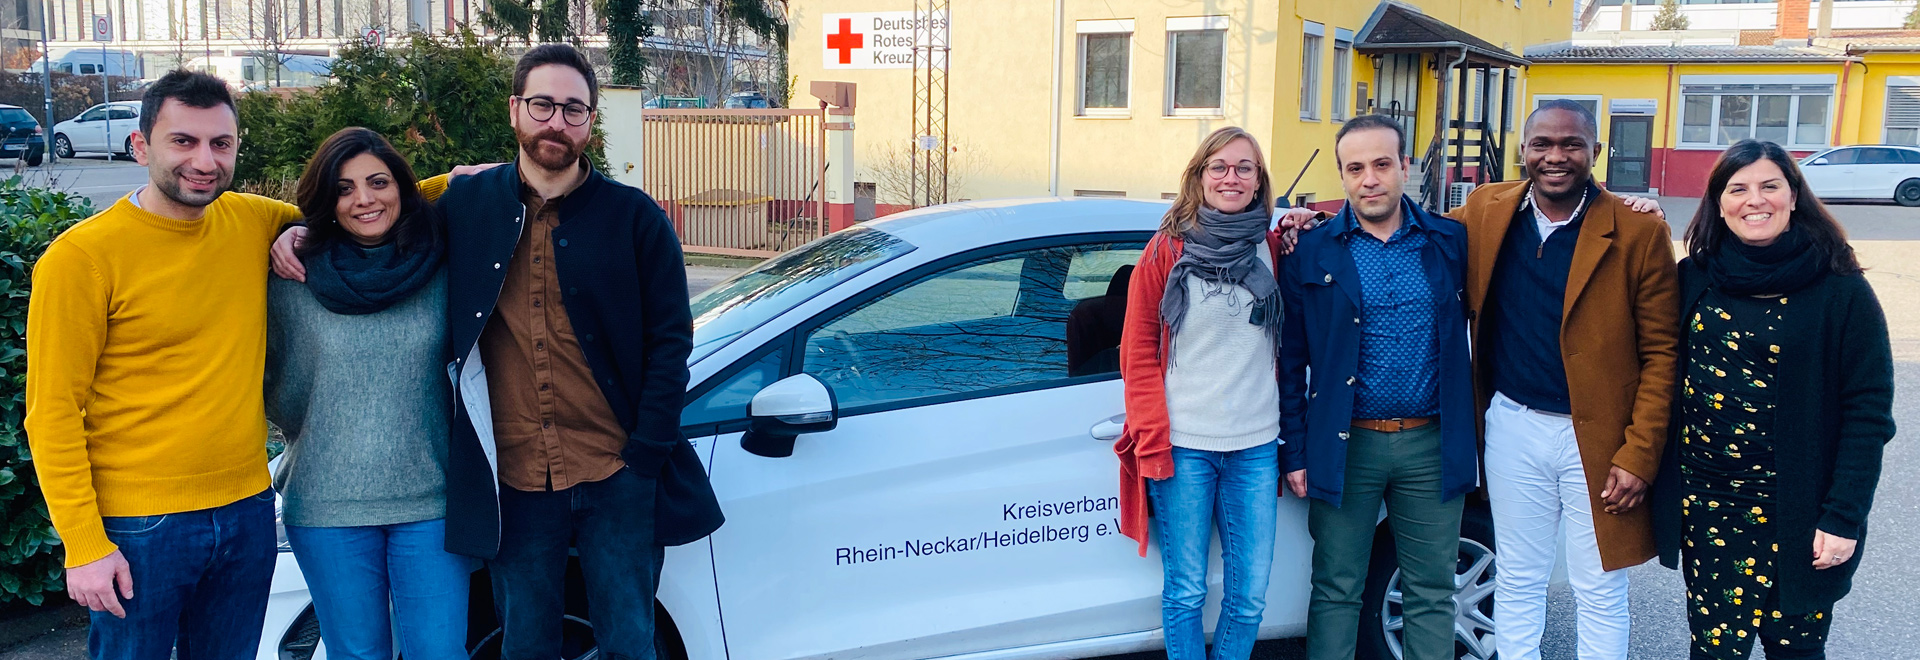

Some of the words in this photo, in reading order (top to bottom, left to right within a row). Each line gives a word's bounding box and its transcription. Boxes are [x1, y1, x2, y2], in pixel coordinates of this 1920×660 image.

[873, 16, 948, 31] Deutsches
[873, 34, 913, 47] Rotes
[873, 51, 913, 64] Kreuz
[1003, 496, 1120, 521] Kreisverban
[836, 524, 1089, 566] Rhein-Neckar/Heidelberg
